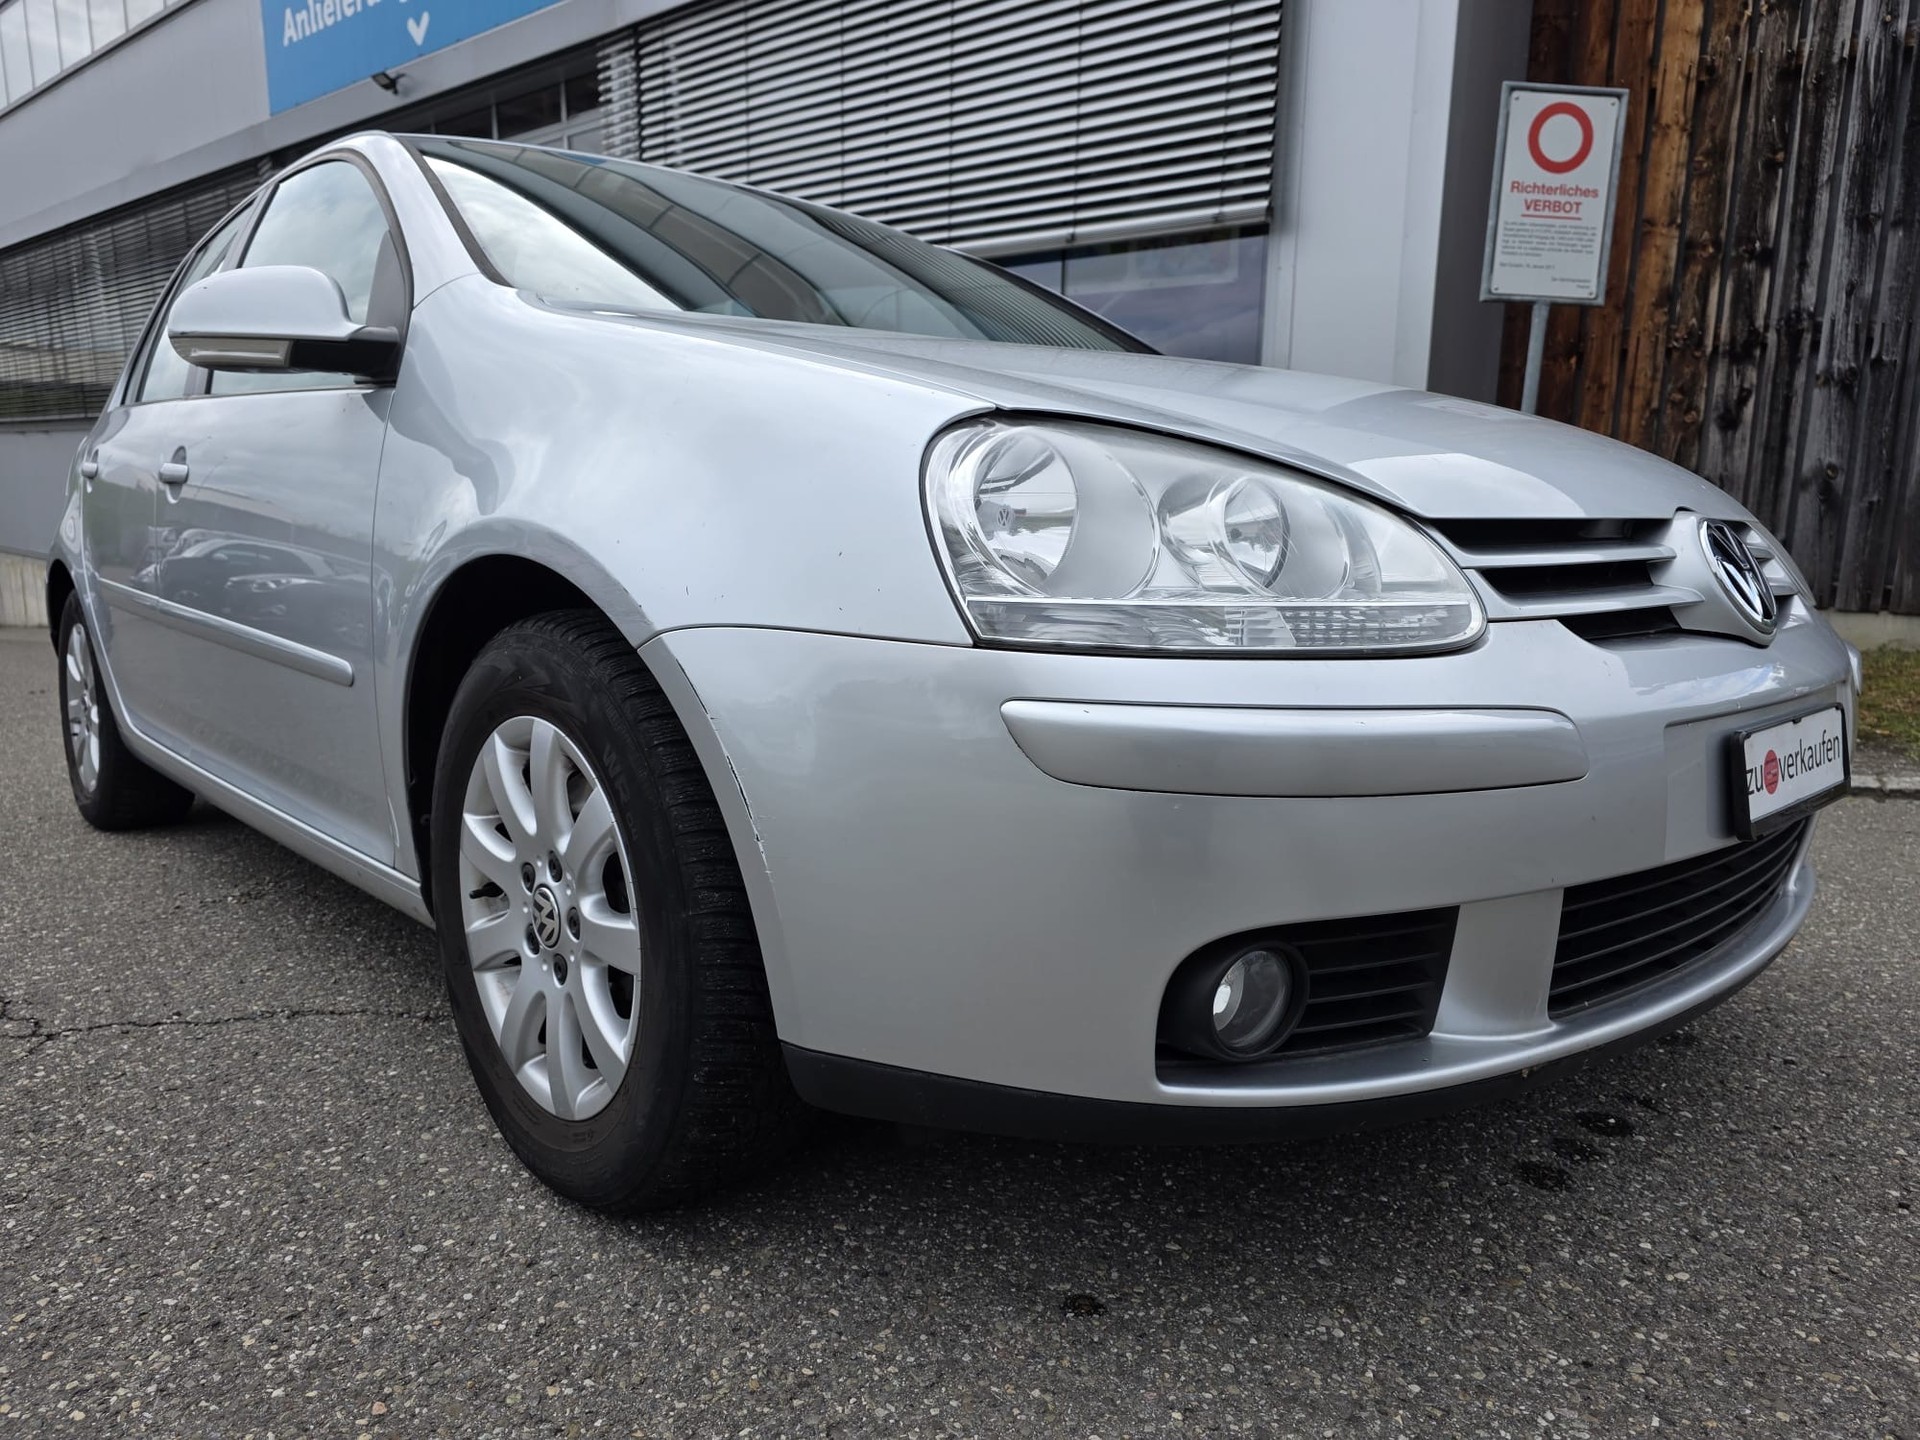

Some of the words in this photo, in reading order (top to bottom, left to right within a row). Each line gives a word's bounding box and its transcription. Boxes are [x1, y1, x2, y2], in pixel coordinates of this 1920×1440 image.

[283, 0, 407, 47] Anliefer
[1510, 180, 1599, 198] Richterliches
[1524, 199, 1582, 214] VERBOT
[1746, 764, 1764, 795] zu
[1778, 729, 1840, 782] verkaufen
